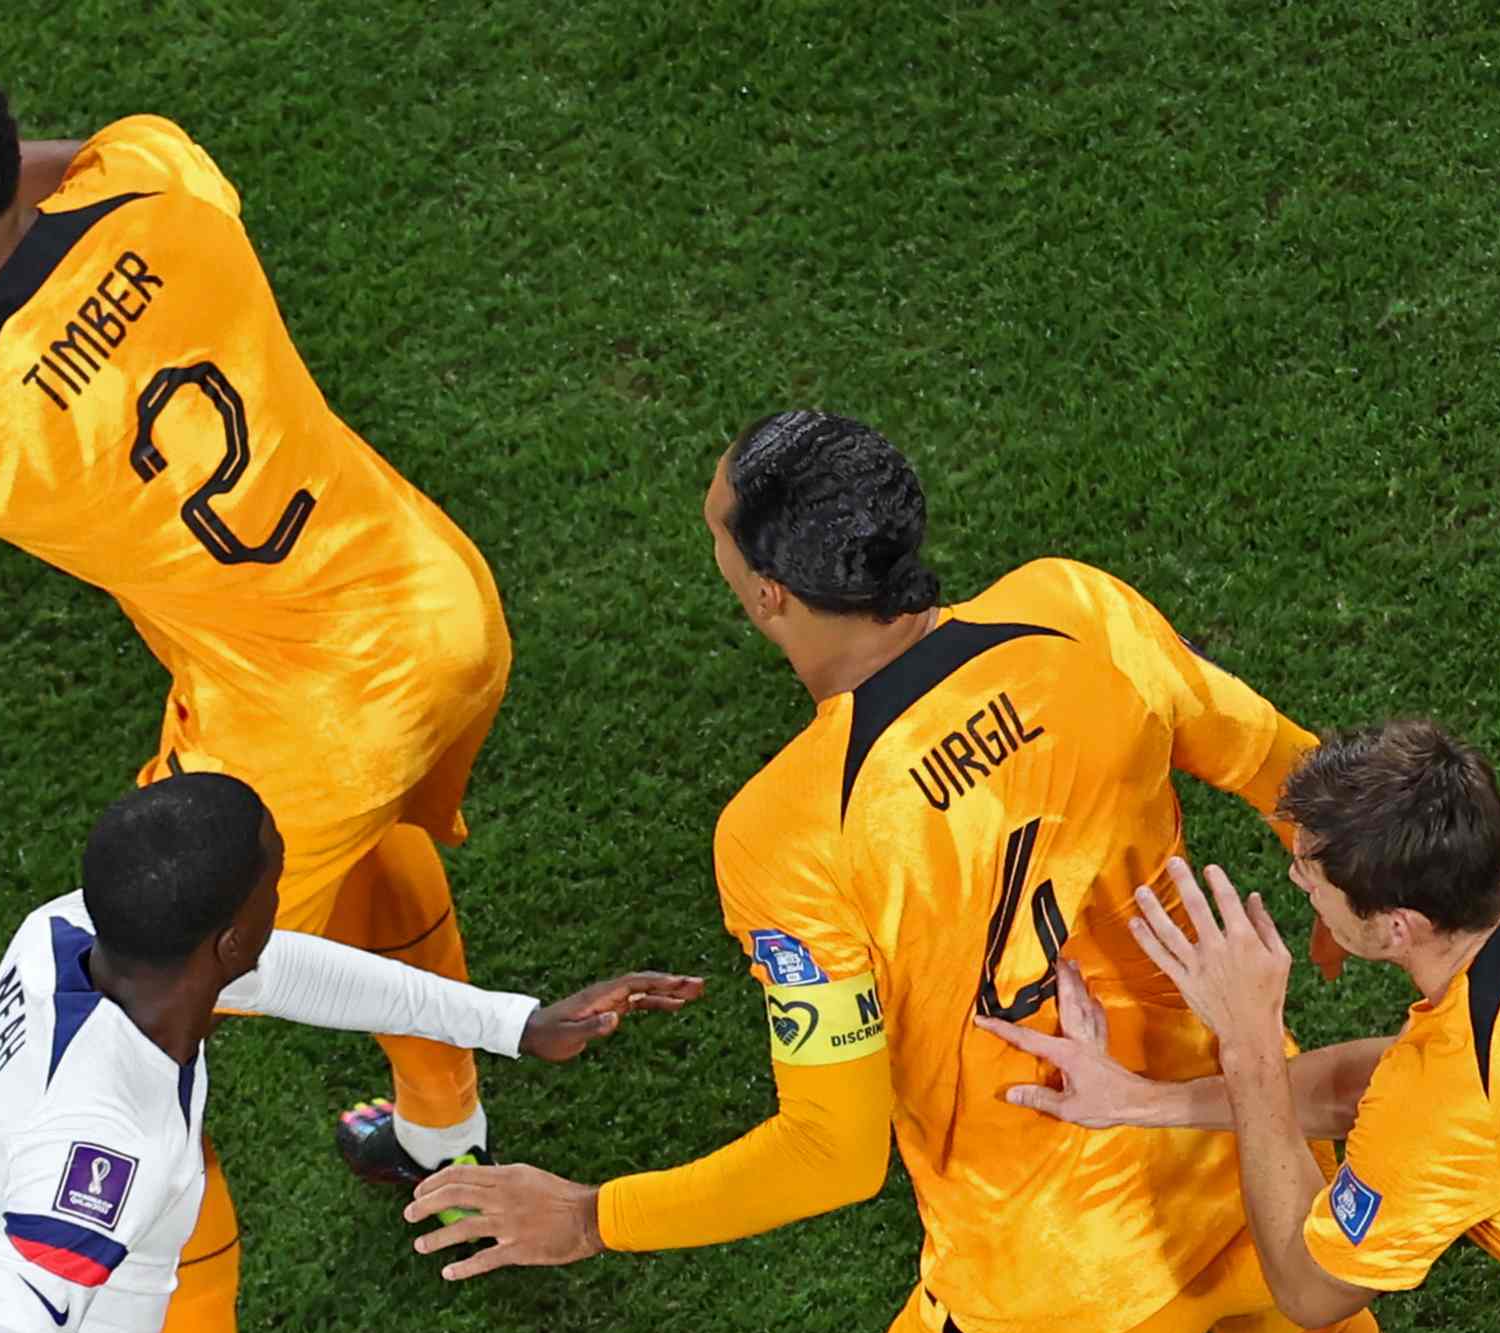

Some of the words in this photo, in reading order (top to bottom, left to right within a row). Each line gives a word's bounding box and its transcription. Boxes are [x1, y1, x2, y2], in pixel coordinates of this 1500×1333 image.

[21, 250, 164, 412] TIMBER
[129, 360, 318, 566] 2
[908, 692, 1046, 812] VIRGIL
[975, 815, 1070, 1024] 4
